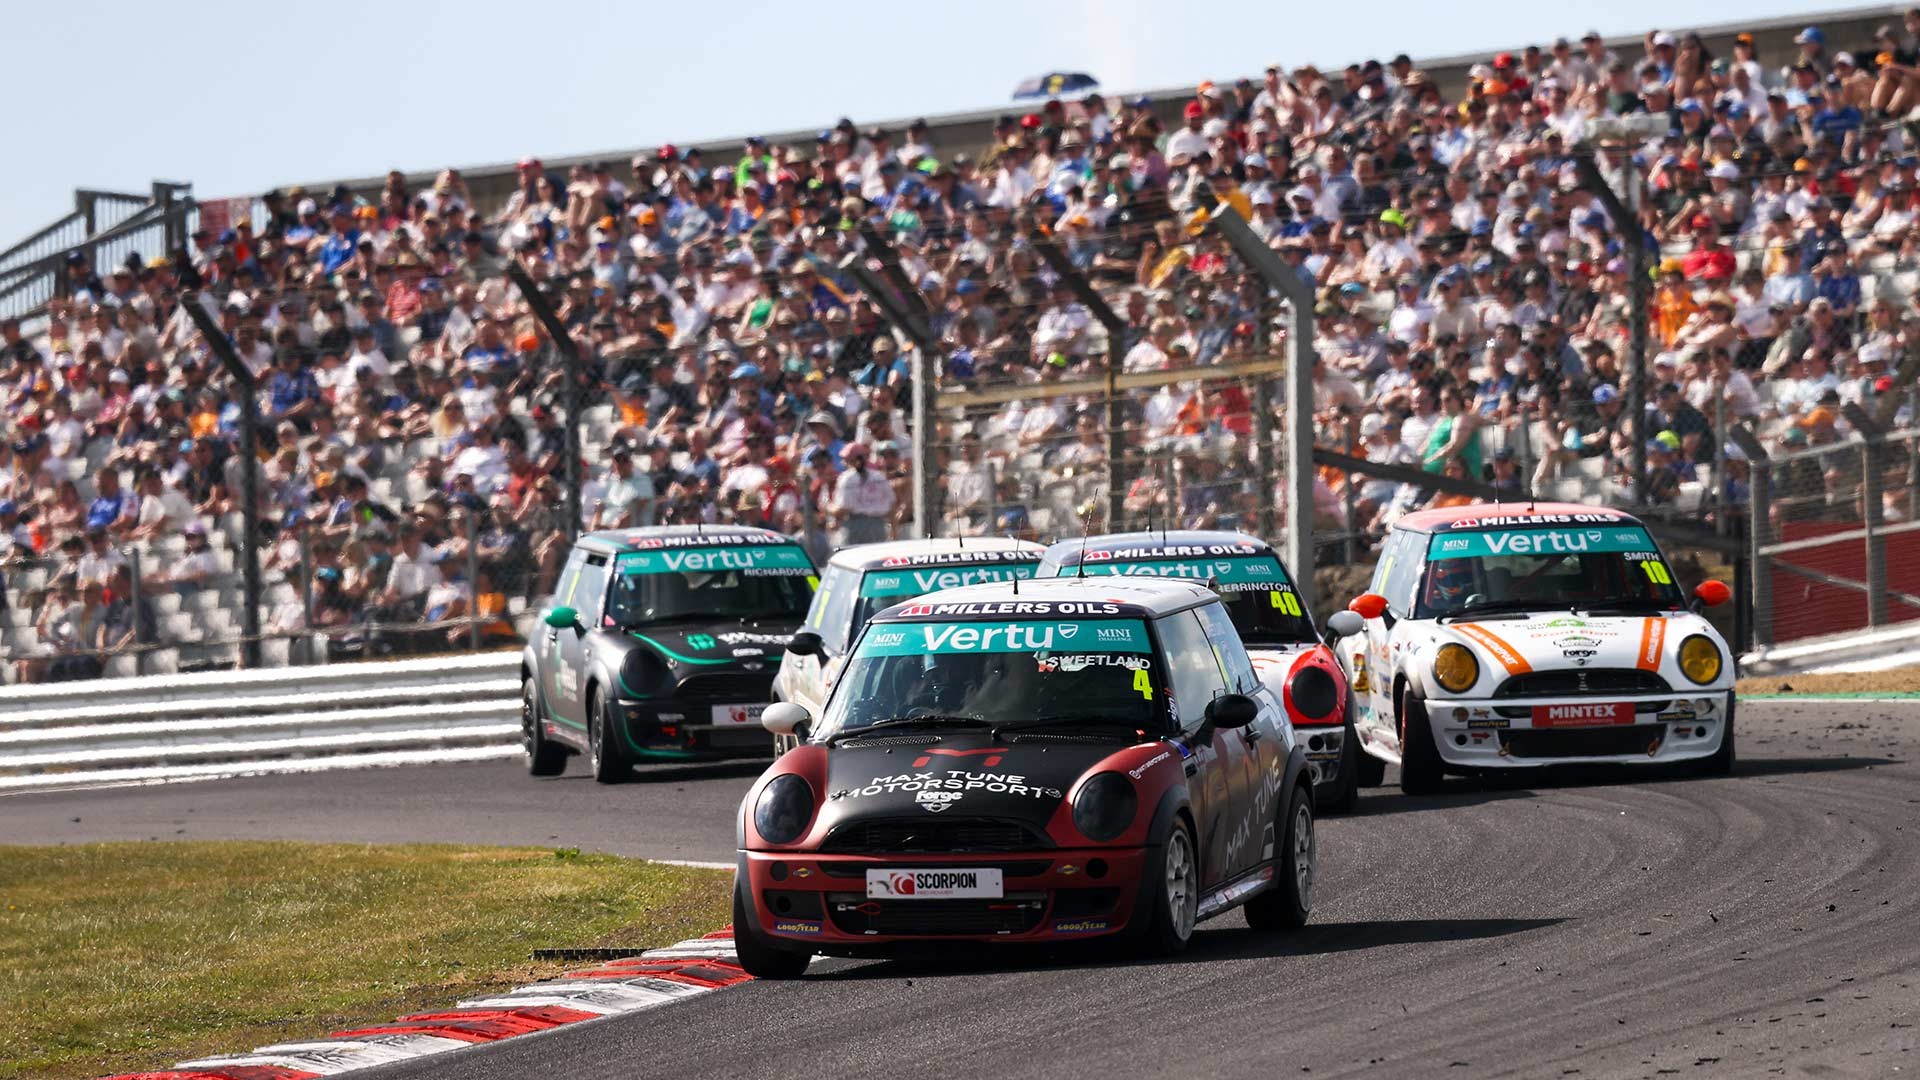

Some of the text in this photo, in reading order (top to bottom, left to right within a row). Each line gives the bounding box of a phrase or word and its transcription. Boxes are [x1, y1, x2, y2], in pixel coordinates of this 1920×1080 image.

[1481, 514, 1621, 526] MILLERS OILS
[664, 533, 786, 547] MILLERS OILS
[1483, 531, 1587, 553] Vertu
[662, 549, 754, 570] Vertu
[912, 551, 1044, 565] MILLERS OILS
[1113, 545, 1256, 559] MILLERS OILS
[1623, 552, 1660, 561] SMITH
[1640, 560, 1671, 585] 10
[935, 602, 1119, 615] MILLERS OILS
[1271, 591, 1302, 617] 40
[874, 633, 906, 642] MINI
[922, 623, 1054, 651] Vertu
[1096, 629, 1130, 637] MINI
[1049, 654, 1150, 670] SWEETLAND
[1133, 669, 1153, 700] 4
[1549, 704, 1617, 719] MINTEX
[872, 770, 1026, 785] MAX TUNE
[839, 778, 1044, 802] MOTORSPORT
[1225, 756, 1281, 870] MAX TUNE
[916, 872, 977, 889] SCORPION
[776, 923, 820, 933] GOODYEAR
[1057, 921, 1106, 931] GOODYEAR
